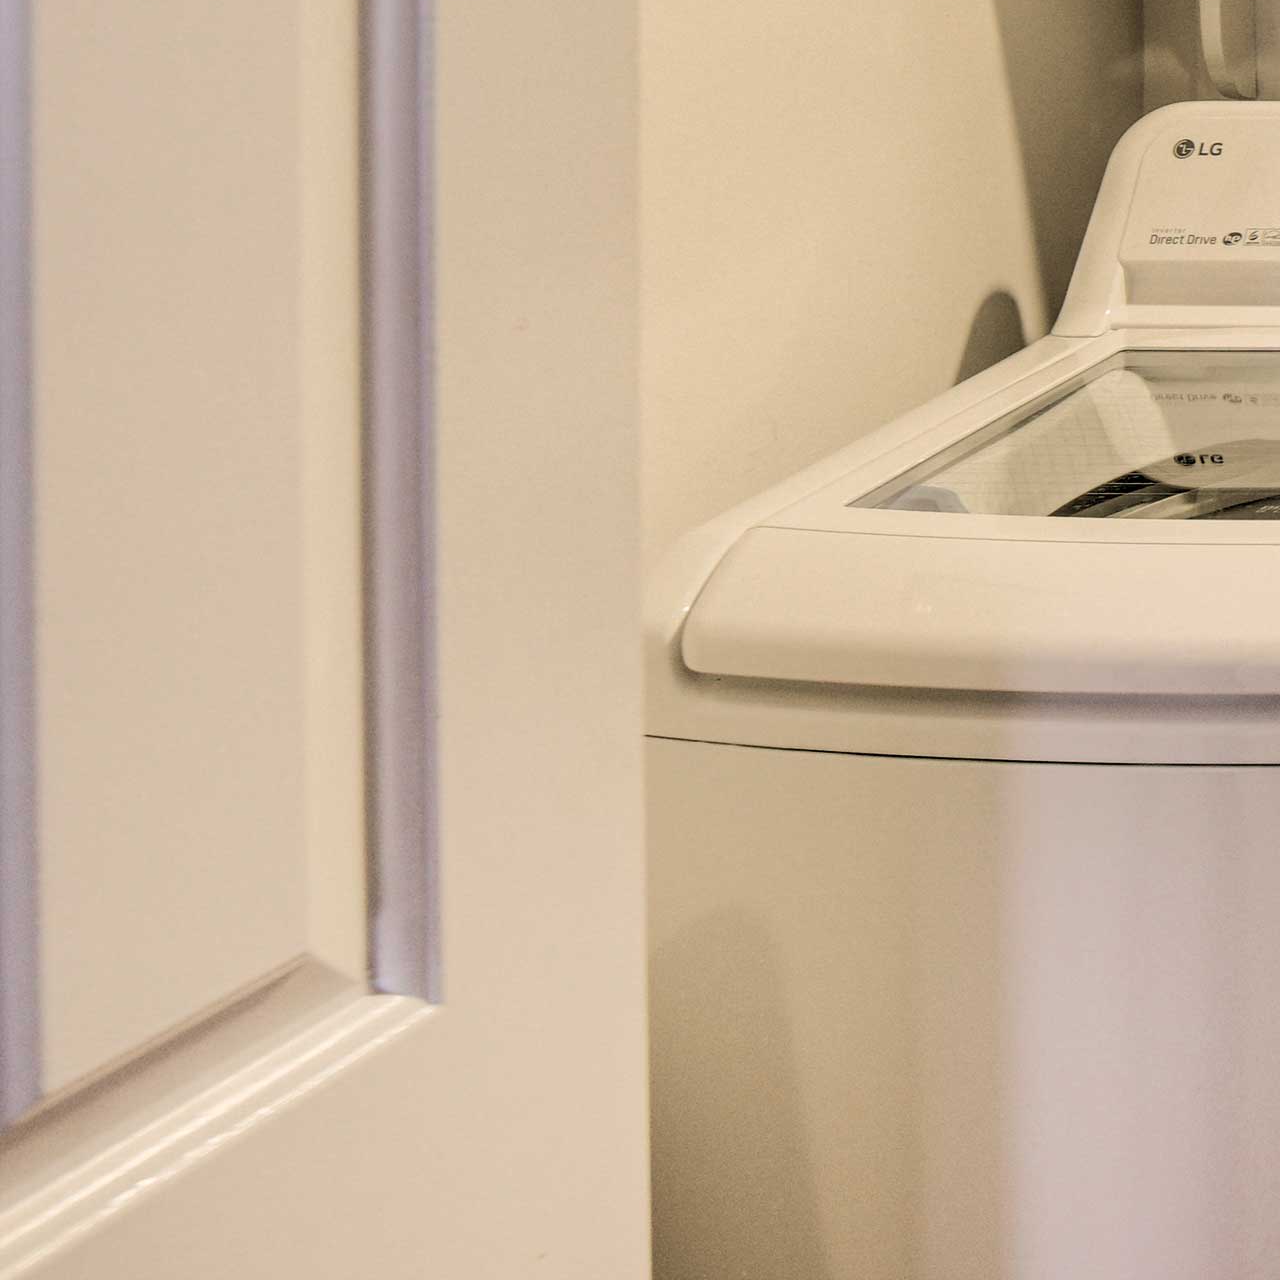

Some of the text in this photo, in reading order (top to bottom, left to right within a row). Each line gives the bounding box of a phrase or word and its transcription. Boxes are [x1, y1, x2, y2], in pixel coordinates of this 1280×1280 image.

[1198, 142, 1223, 157] LG
[1150, 234, 1184, 245] Direct
[1186, 234, 1217, 245] Drive
